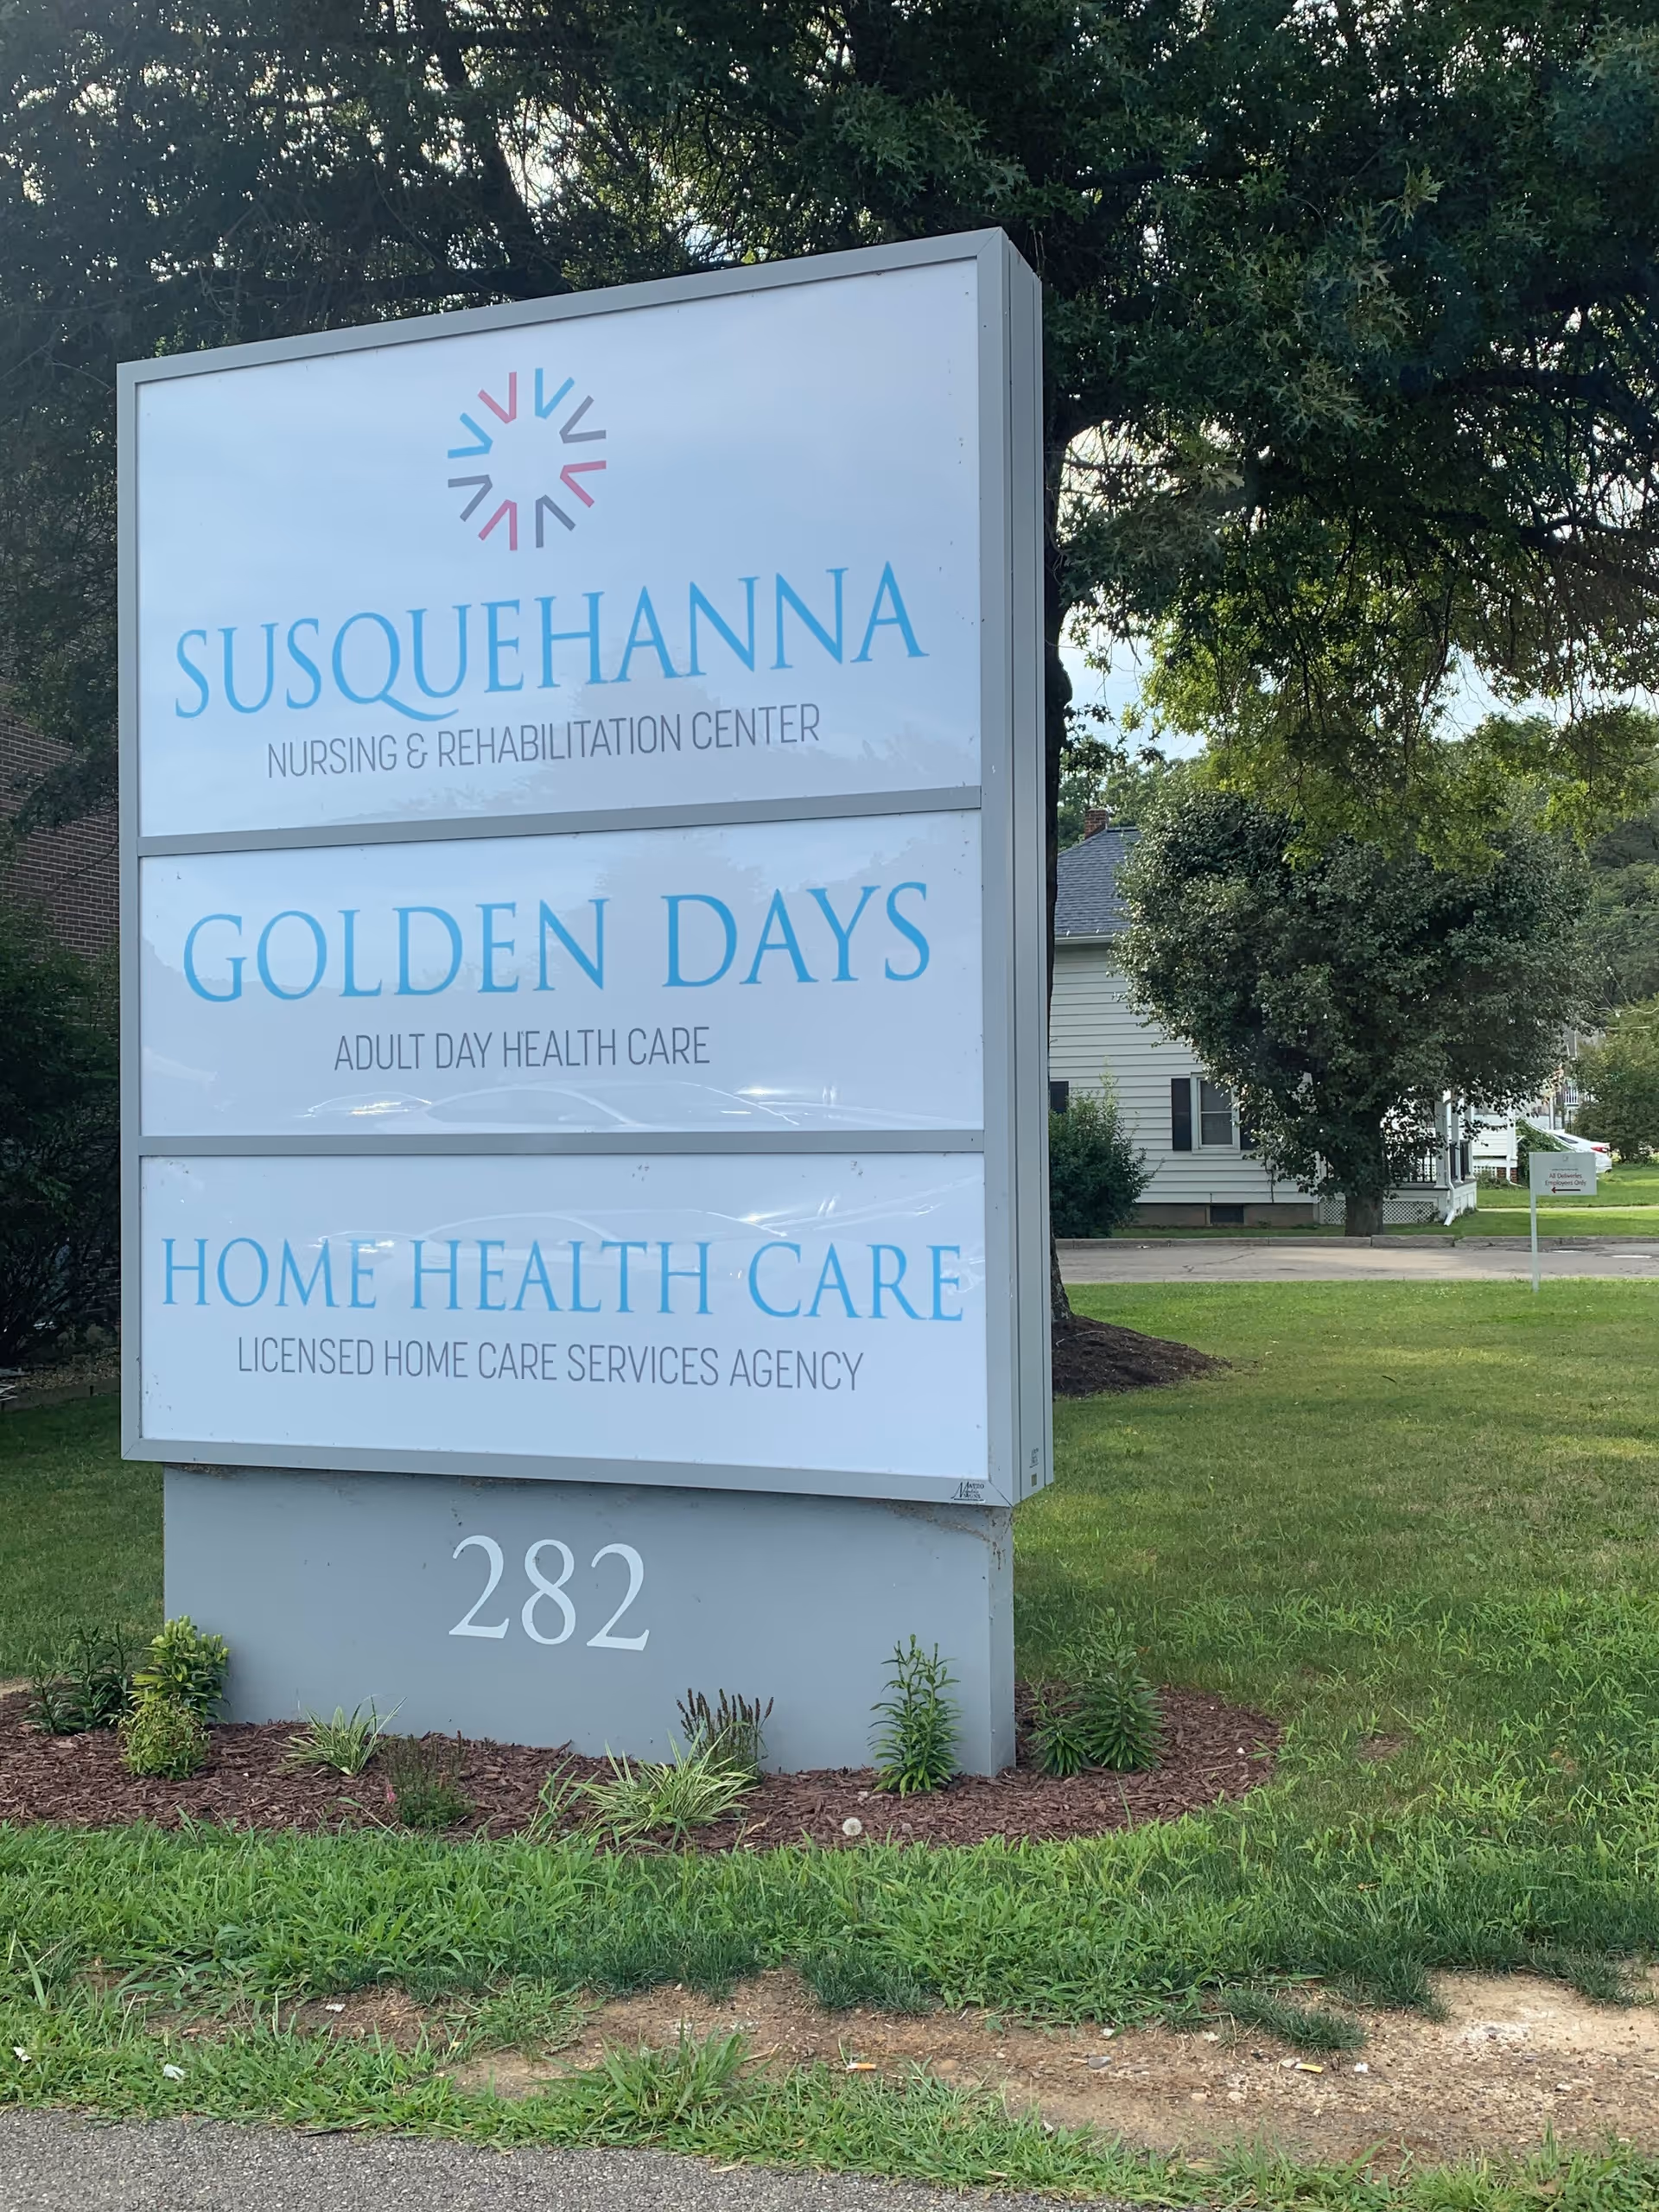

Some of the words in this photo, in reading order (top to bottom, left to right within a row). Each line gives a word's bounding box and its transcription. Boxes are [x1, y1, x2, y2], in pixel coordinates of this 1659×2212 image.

[175, 560, 931, 722] SUSQUEHANNA
[266, 734, 398, 779] NURSING
[406, 732, 429, 770] &
[437, 713, 682, 768] REHABILITATION
[691, 702, 820, 751] CENTER
[183, 898, 612, 1003] GOLDEN
[659, 880, 931, 988] DAYS
[334, 1033, 426, 1071] ADULT
[435, 1031, 493, 1070] DAY
[503, 1028, 616, 1068] HEALTH
[627, 1026, 711, 1065] CARE
[161, 1236, 378, 1310] HOME
[409, 1238, 714, 1315] HEALTH
[747, 1241, 964, 1322] CARE
[238, 1336, 374, 1376] LICENSED
[385, 1338, 469, 1378] HOME
[478, 1341, 557, 1381] CARE
[567, 1343, 719, 1387] SERVICES
[728, 1348, 864, 1391] AGENCY
[448, 1535, 651, 1651] 282
